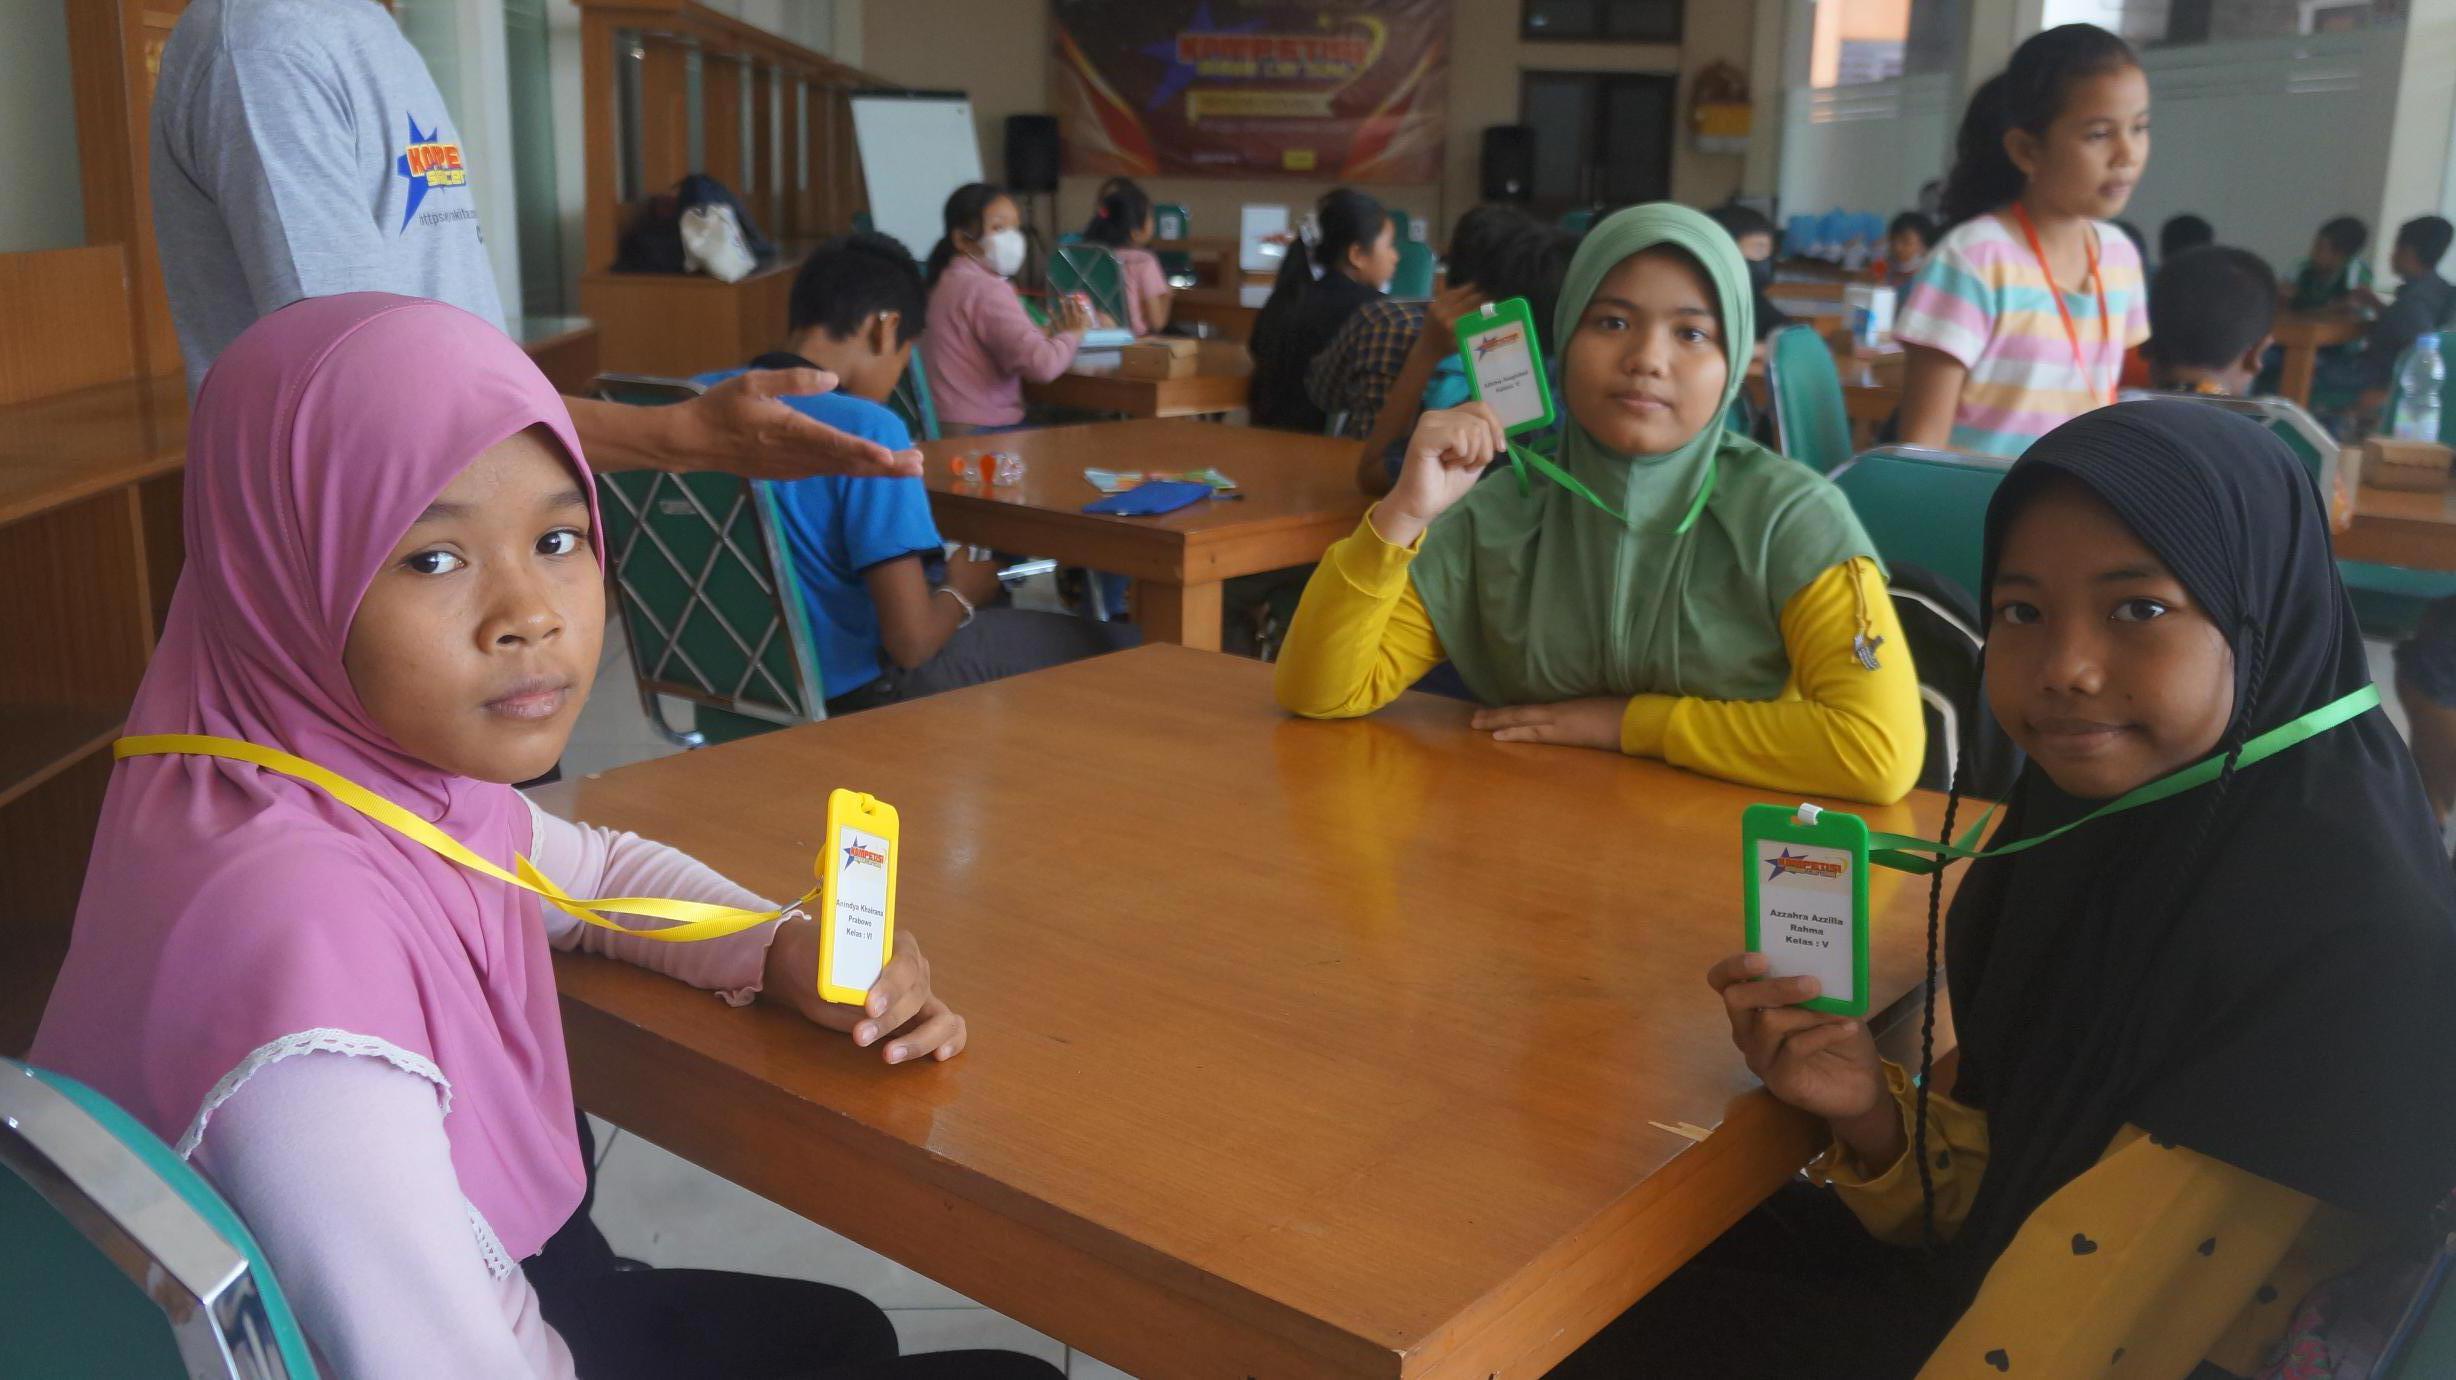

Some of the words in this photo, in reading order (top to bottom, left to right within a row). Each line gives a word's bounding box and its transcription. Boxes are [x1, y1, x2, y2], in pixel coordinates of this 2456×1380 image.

[1770, 908, 1808, 921] Azzahra
[1790, 924, 1824, 935] Rahma
[1785, 935, 1813, 946] Kelas
[1822, 940, 1829, 948] V
